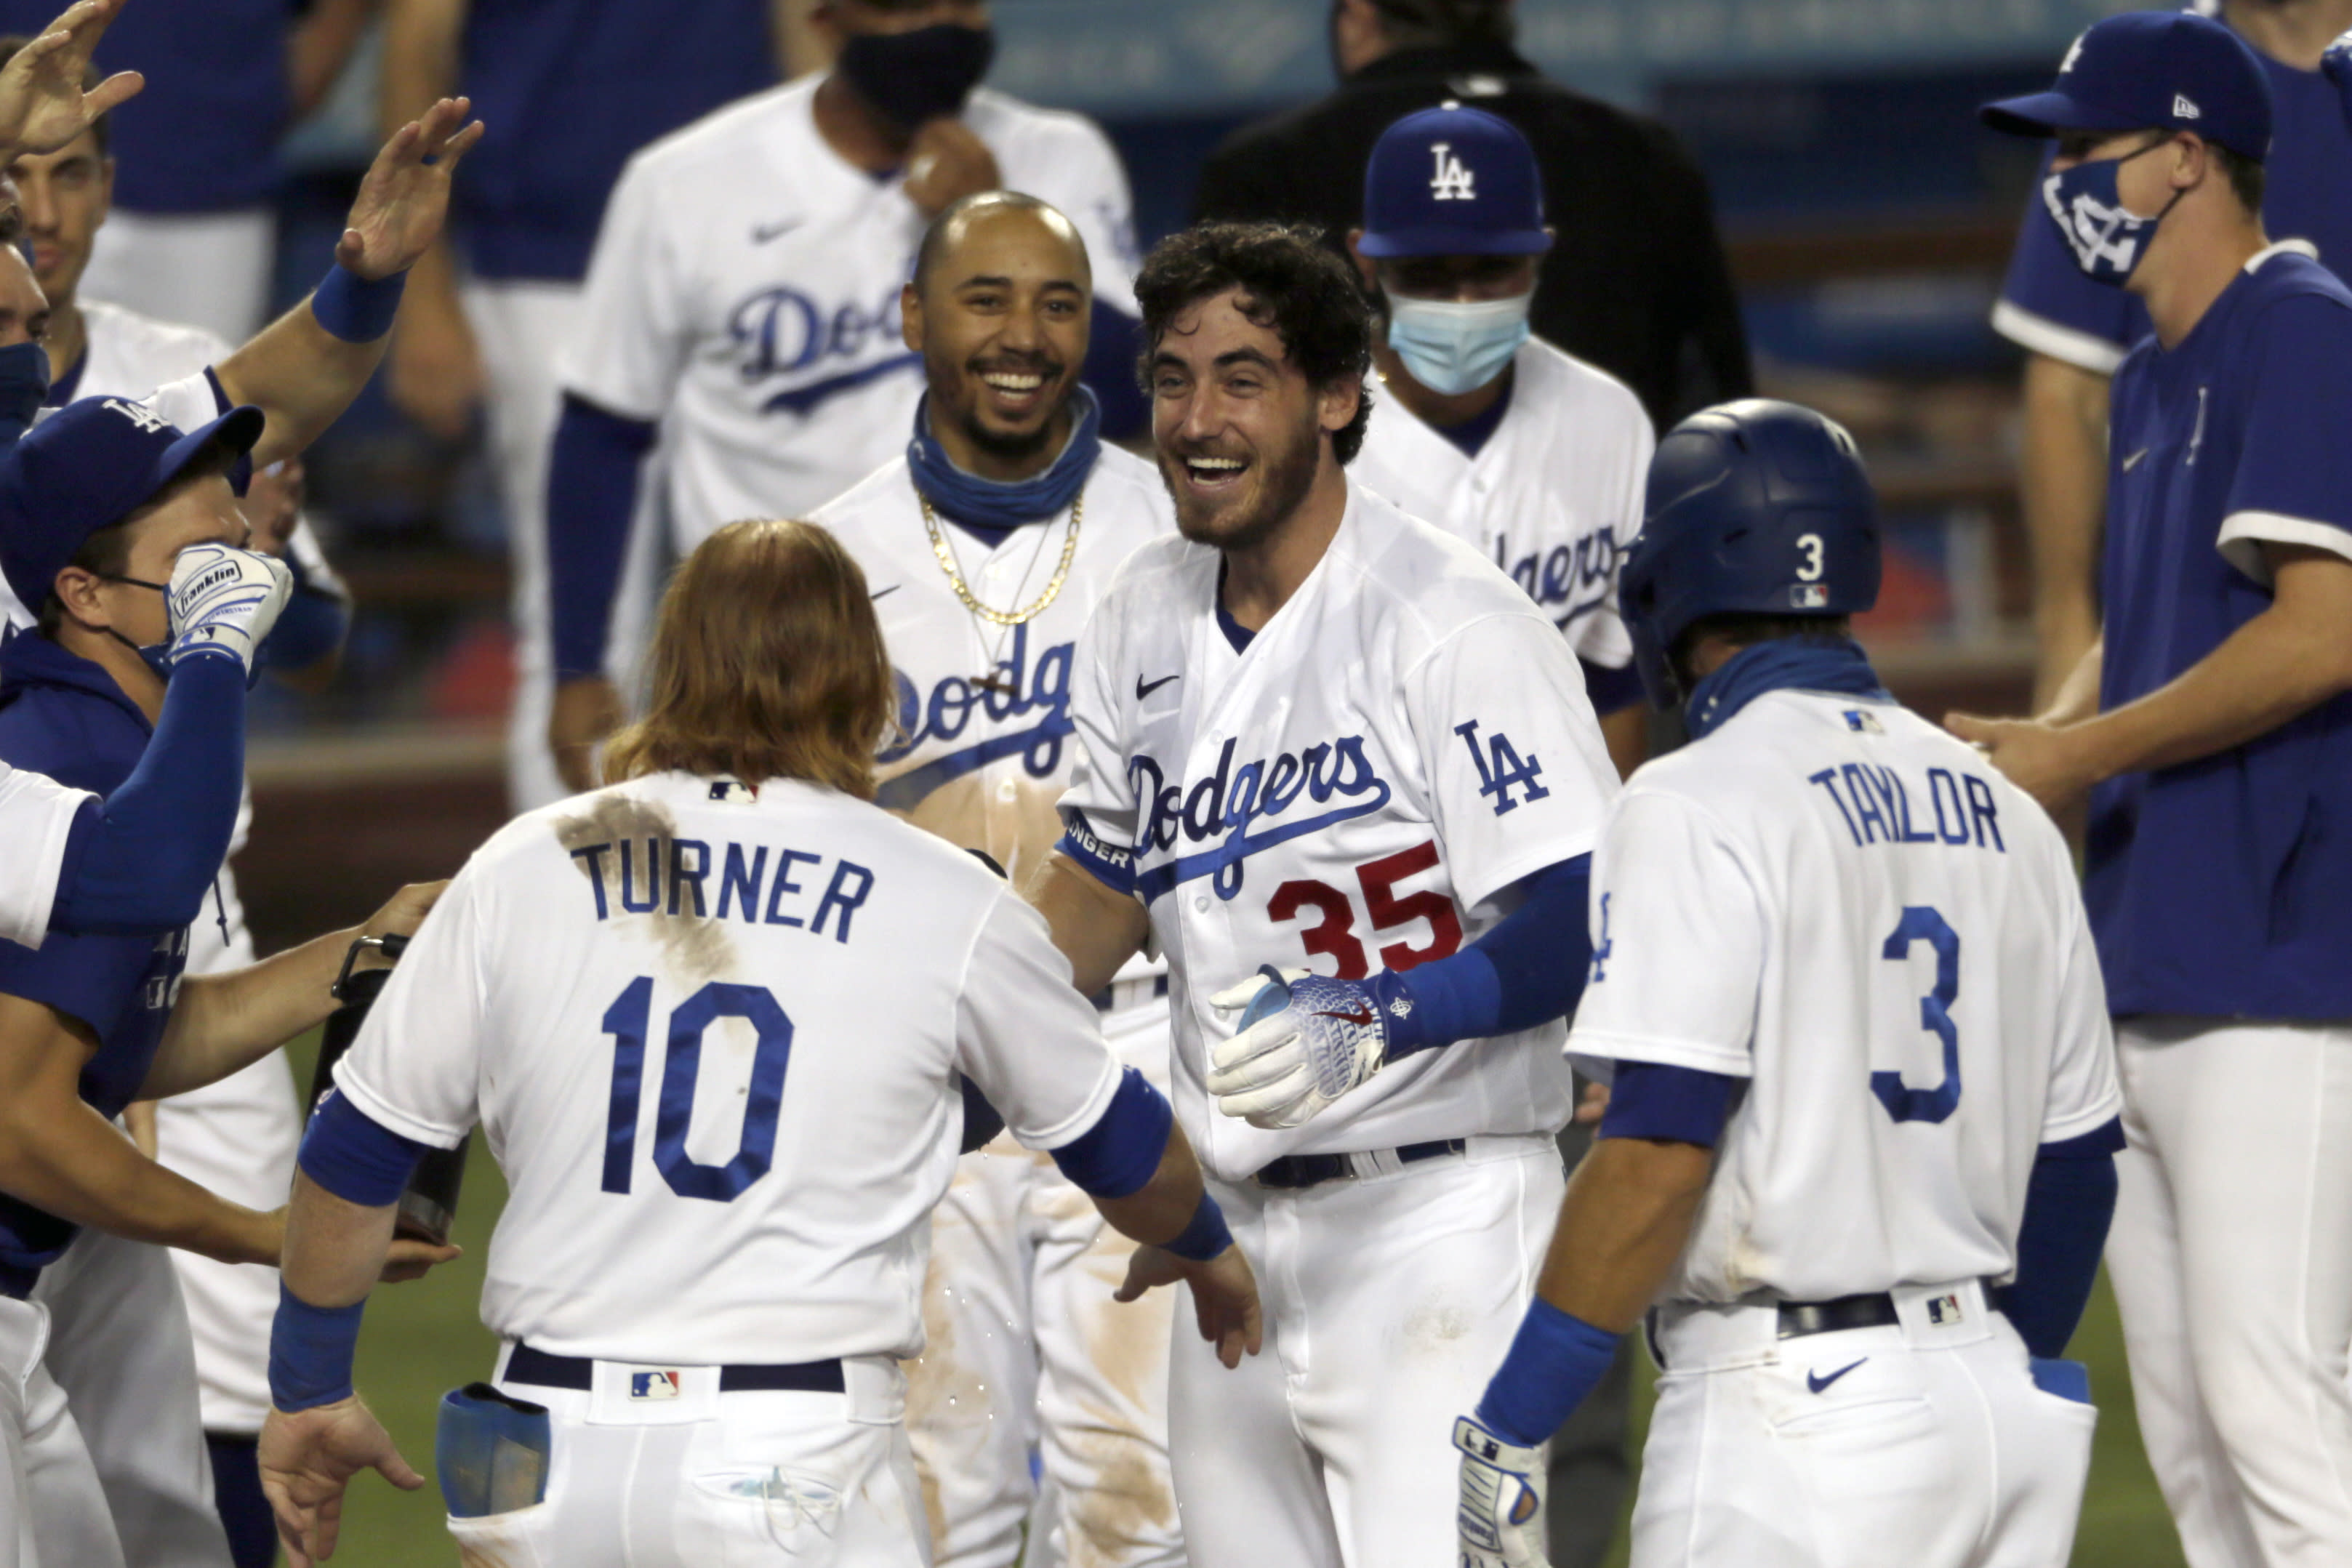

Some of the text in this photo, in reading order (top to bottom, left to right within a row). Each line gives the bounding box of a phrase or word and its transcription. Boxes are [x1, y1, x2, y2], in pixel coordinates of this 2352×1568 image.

[1430, 143, 1477, 200] LA
[2043, 174, 2157, 273] LA
[1796, 534, 1825, 582] 3
[1128, 734, 1392, 902] Dodgers
[1455, 719, 1550, 818] LA
[1807, 763, 2007, 853] TAYLOR
[570, 837, 876, 945] TURNER
[1267, 839, 1463, 983] 35
[1869, 906, 1962, 1125] 3
[601, 975, 795, 1203] 10
